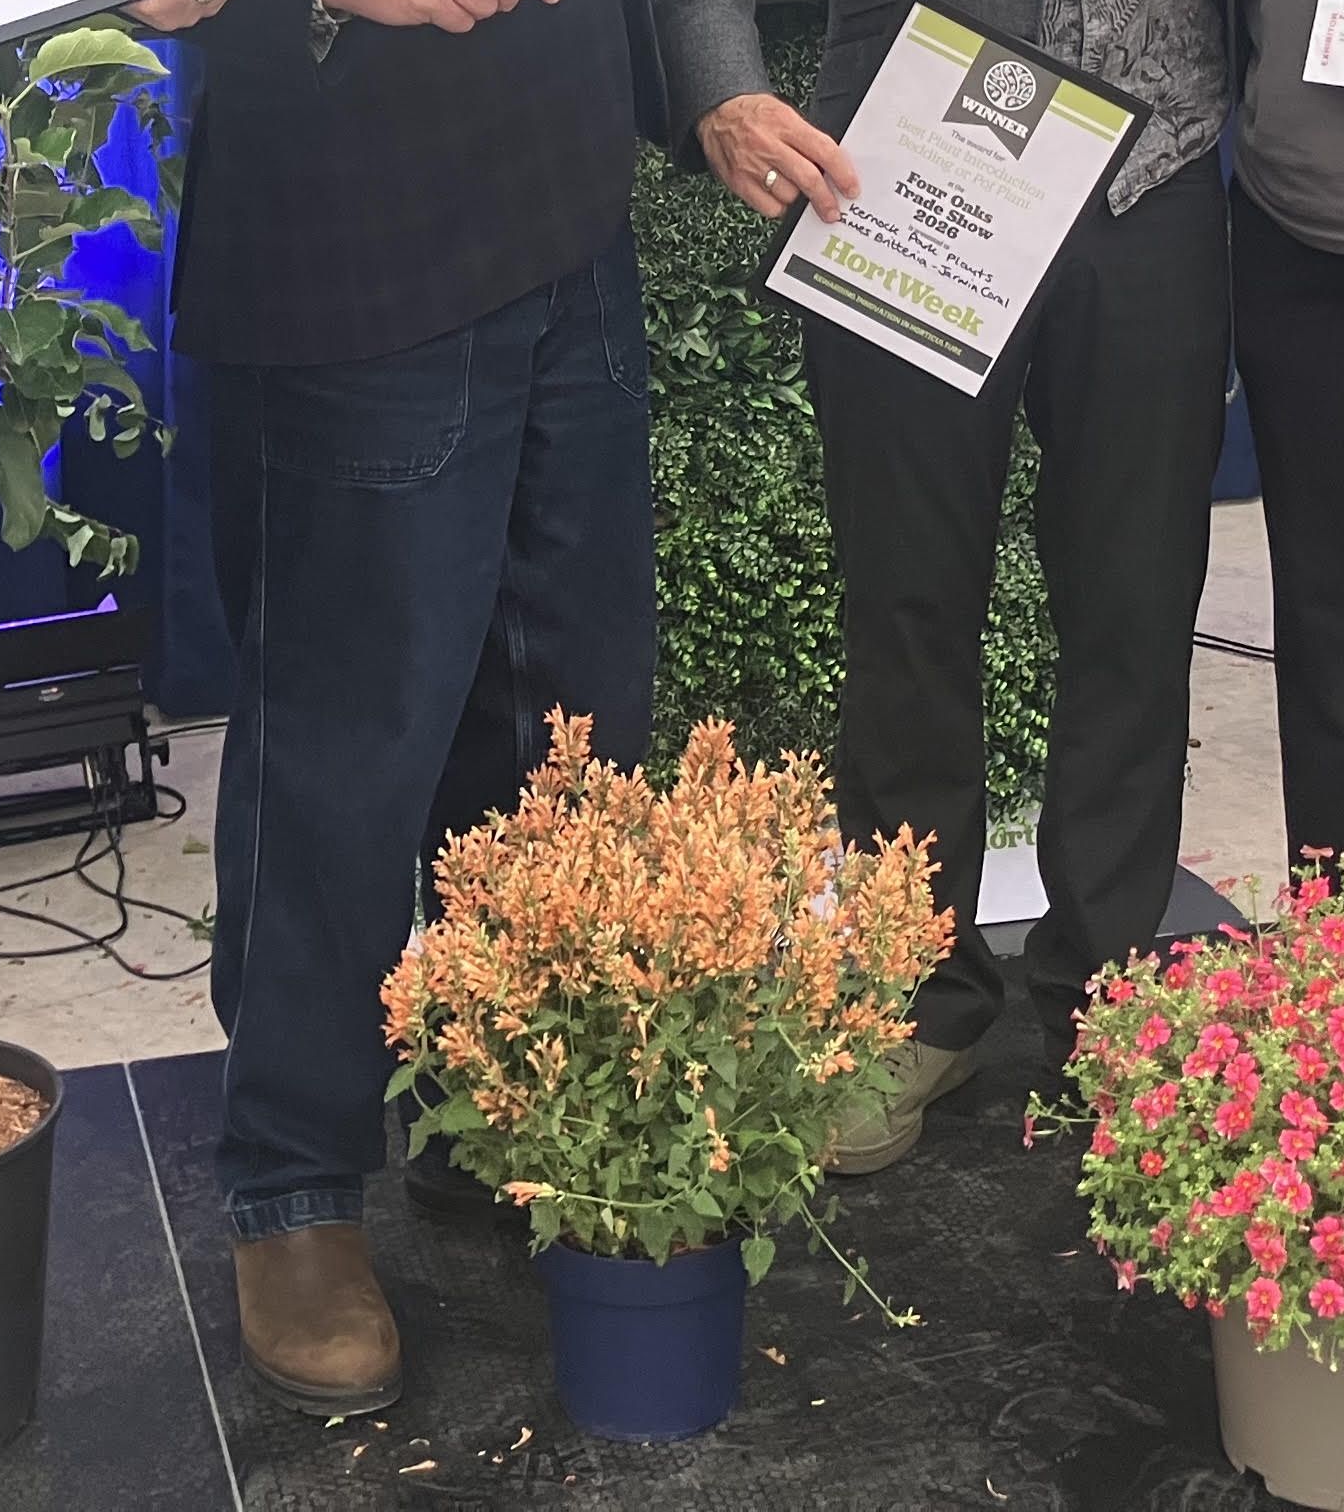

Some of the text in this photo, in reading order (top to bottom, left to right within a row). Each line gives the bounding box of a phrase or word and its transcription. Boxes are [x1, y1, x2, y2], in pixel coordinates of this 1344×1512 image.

[949, 129, 967, 143] The
[957, 94, 1030, 140] WINNER
[905, 170, 995, 225] Four Oaks
[953, 165, 972, 181] or
[994, 183, 1033, 211] Plant
[962, 149, 1048, 202] Introduction
[891, 179, 995, 242] Trade Show
[911, 207, 961, 241] 2026
[847, 202, 995, 284] Kernock Park Plants
[819, 233, 988, 337] HortWeek
